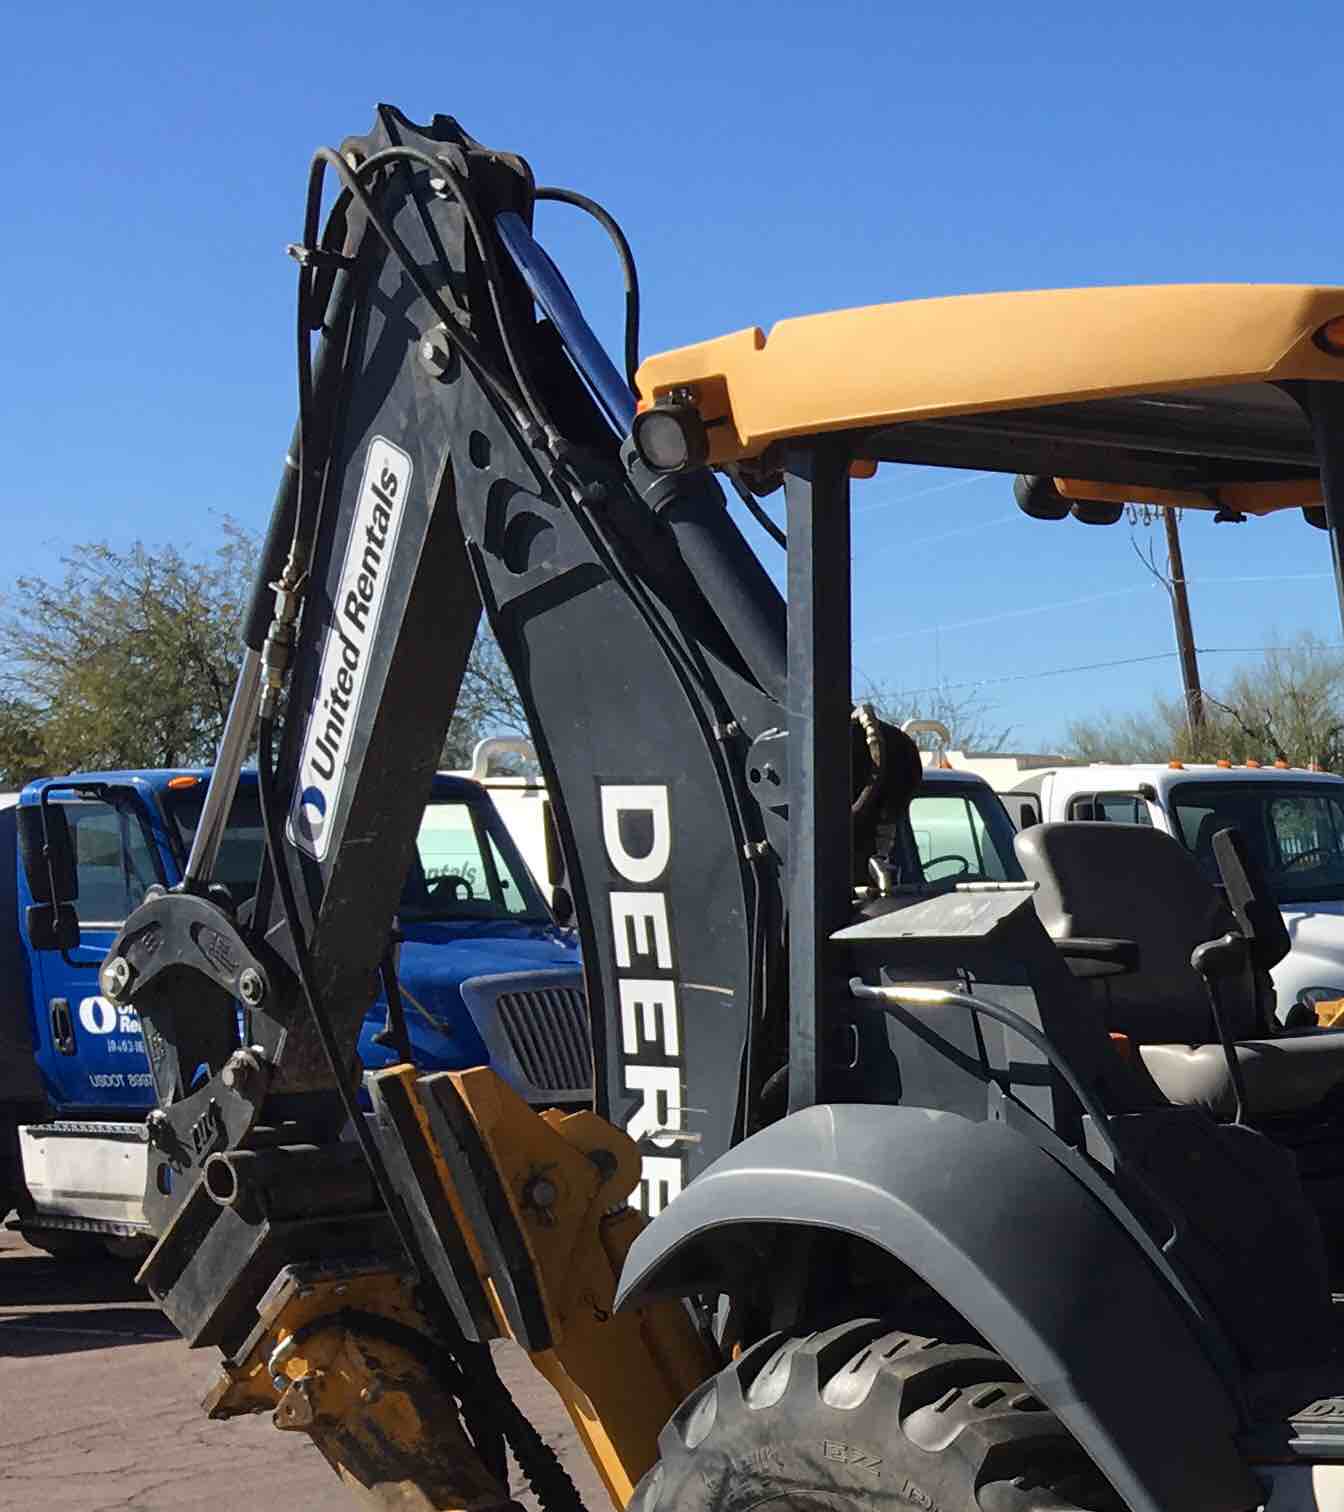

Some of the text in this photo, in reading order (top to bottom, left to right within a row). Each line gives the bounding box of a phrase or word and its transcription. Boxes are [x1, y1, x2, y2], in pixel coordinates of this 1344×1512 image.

[311, 466, 399, 781] United Rentals
[600, 785, 683, 1218] DEERE
